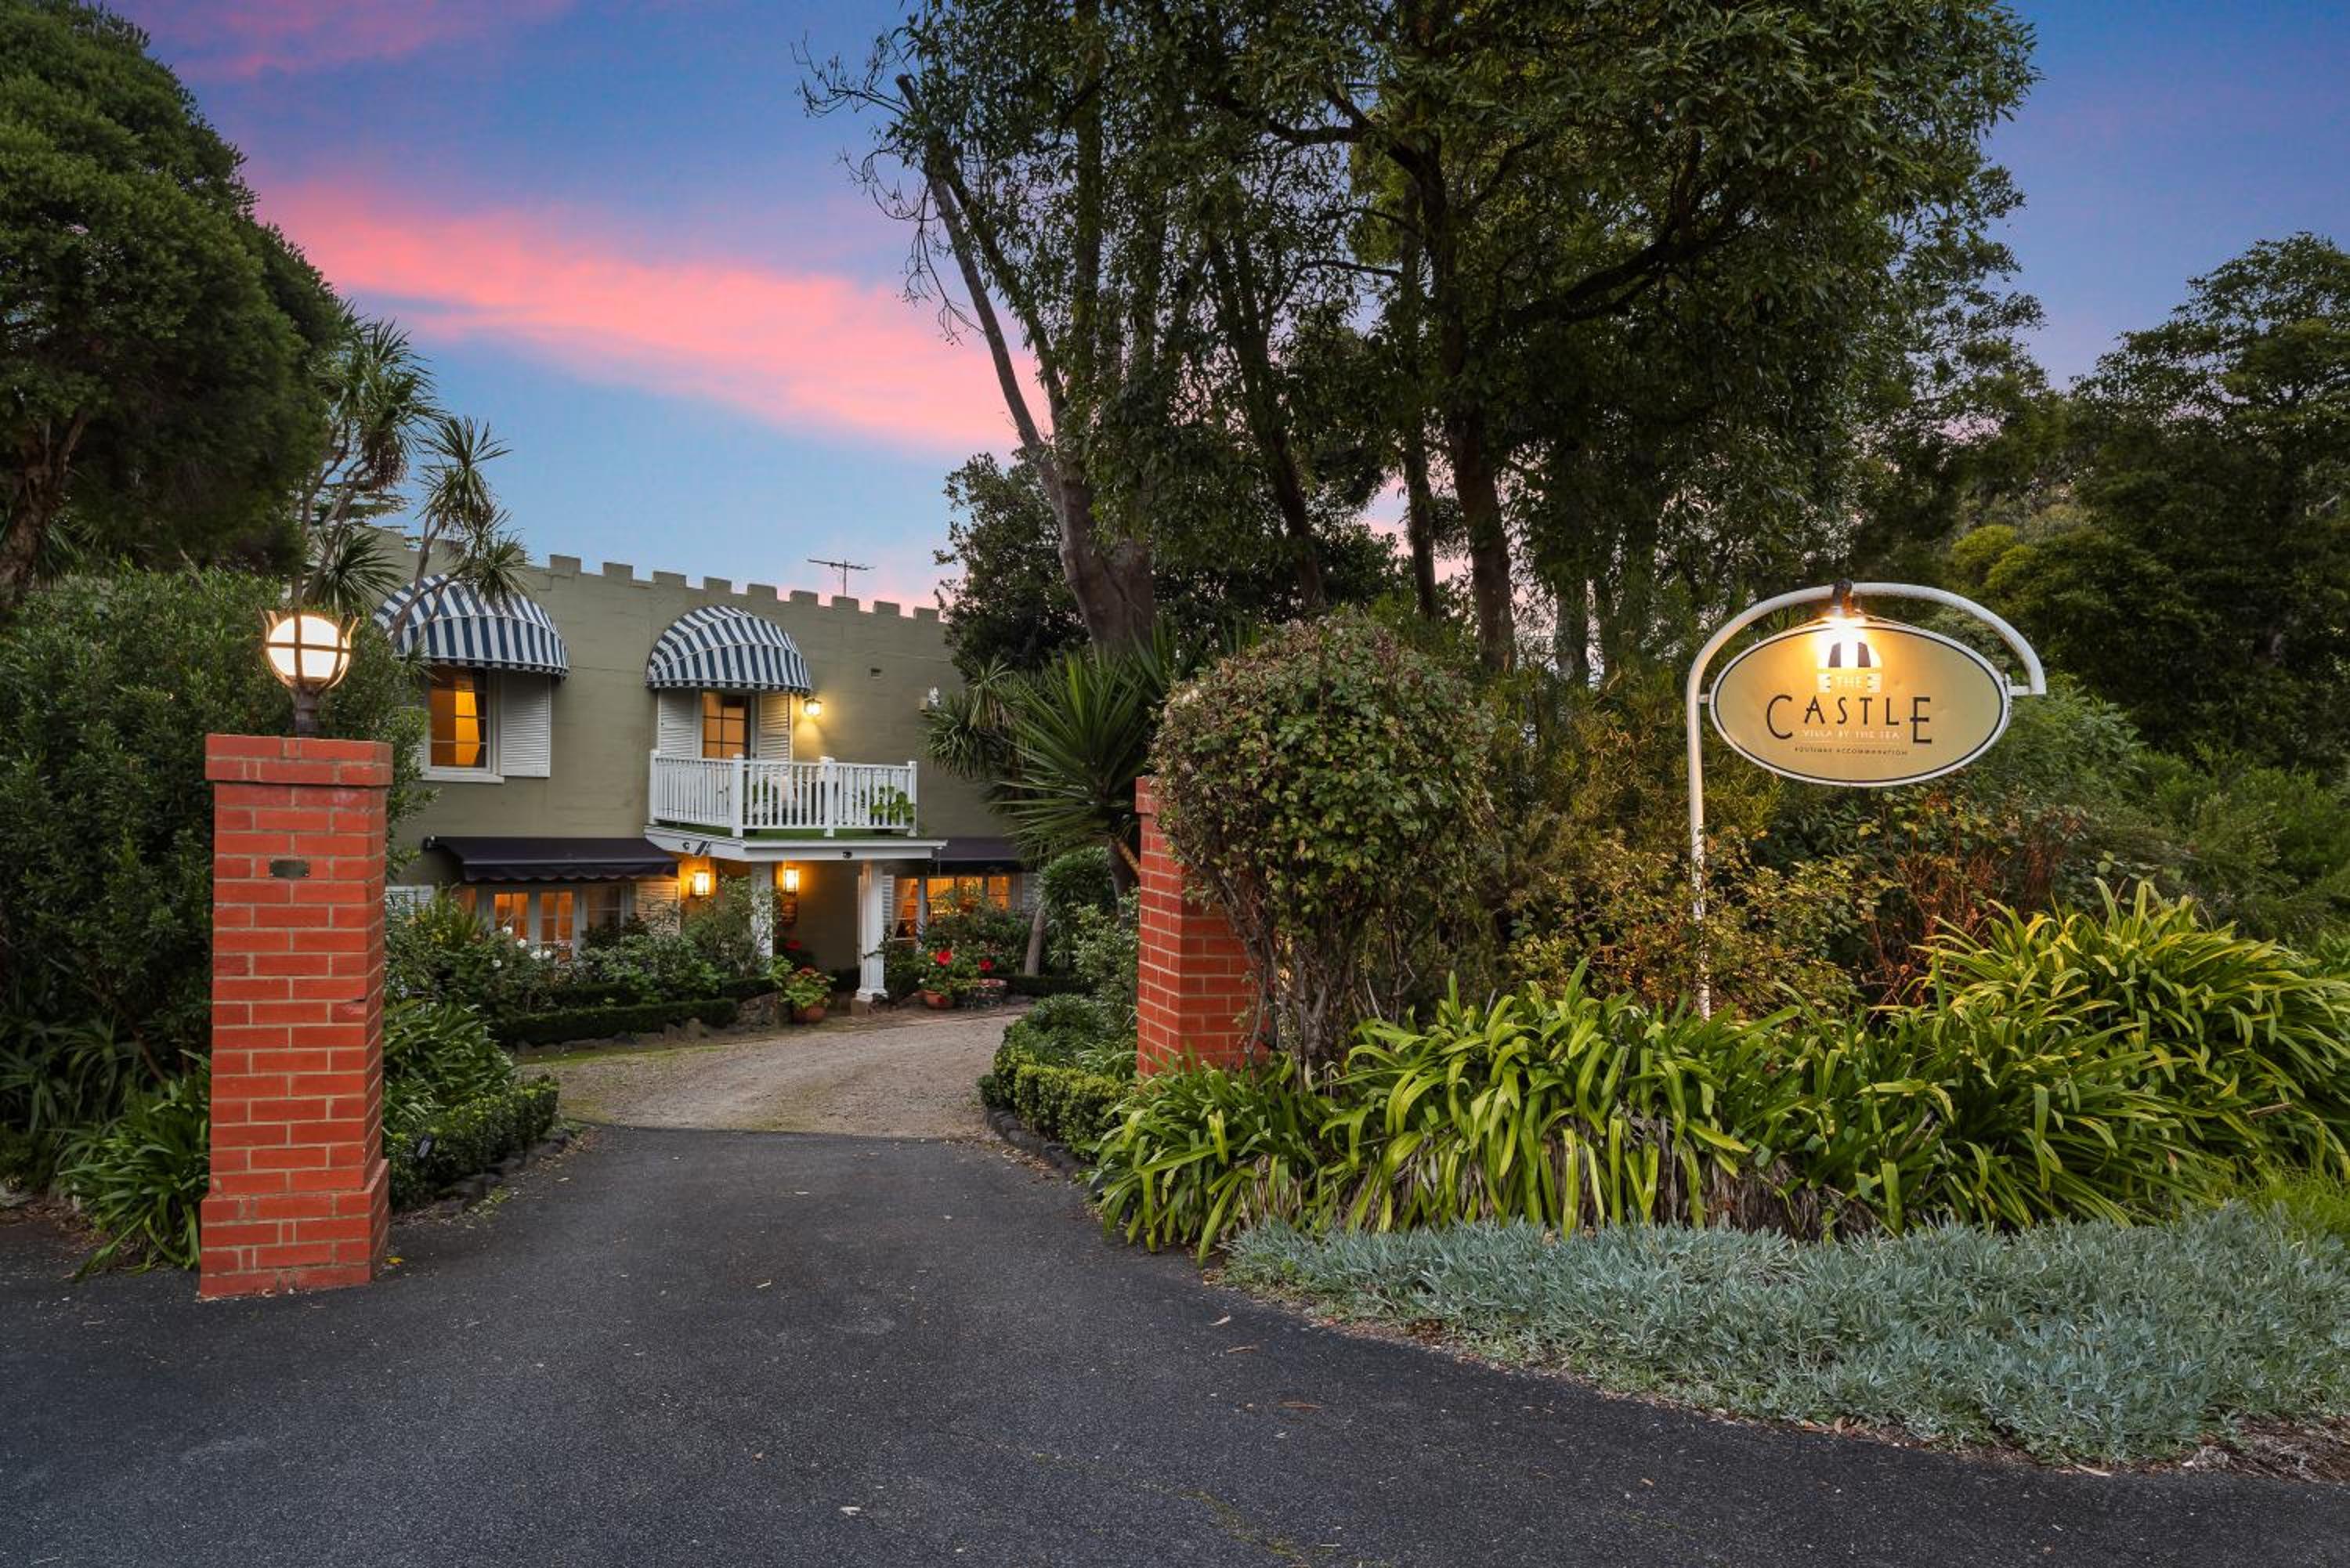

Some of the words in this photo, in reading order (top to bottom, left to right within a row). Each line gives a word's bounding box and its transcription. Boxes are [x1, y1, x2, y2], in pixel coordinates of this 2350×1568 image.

[1835, 676, 1863, 689] THE
[1766, 695, 1932, 744] CASTLE
[1803, 729, 1832, 739] VILLA
[1856, 731, 1876, 739] THE
